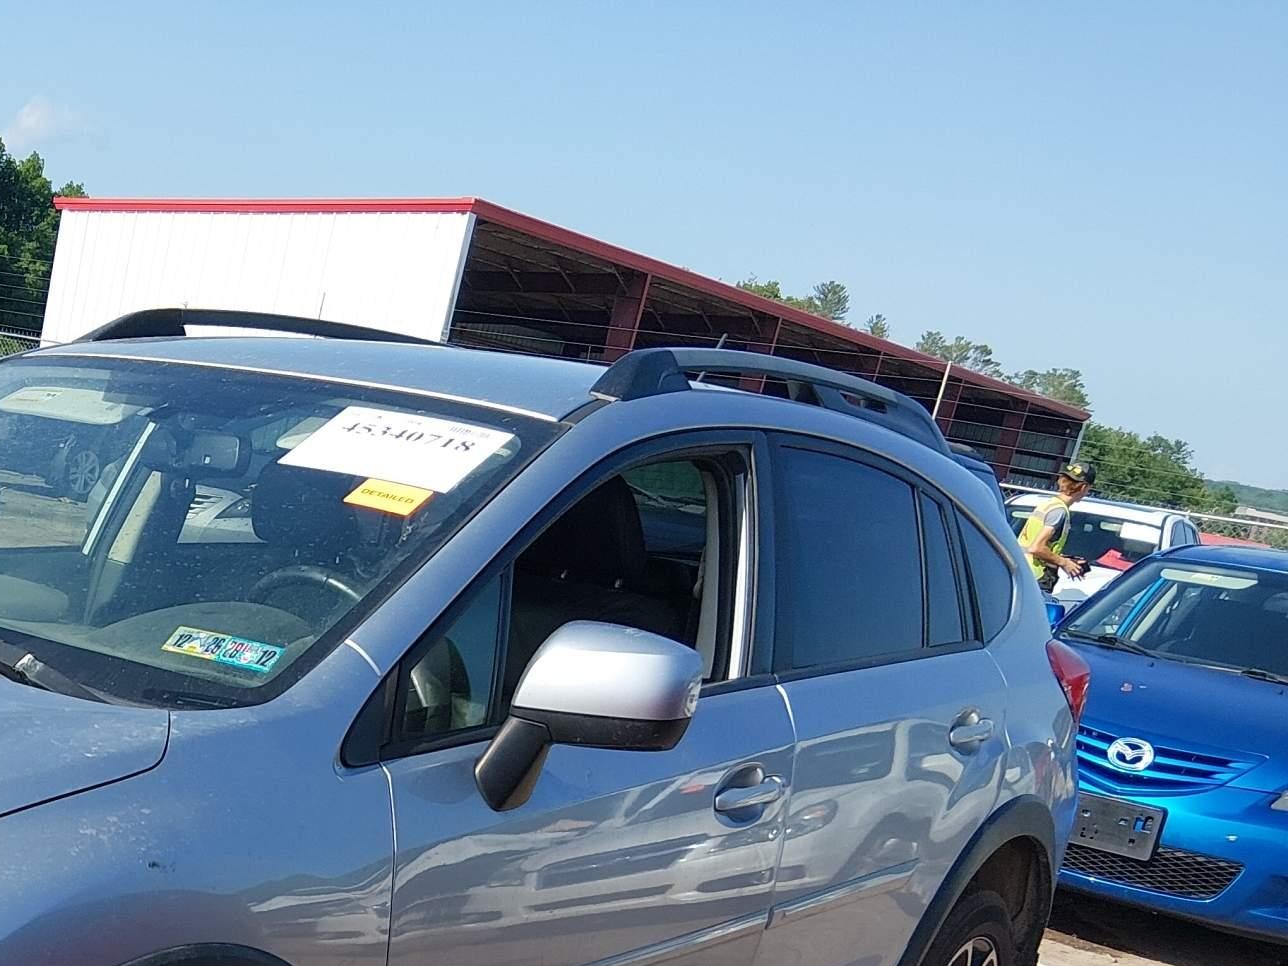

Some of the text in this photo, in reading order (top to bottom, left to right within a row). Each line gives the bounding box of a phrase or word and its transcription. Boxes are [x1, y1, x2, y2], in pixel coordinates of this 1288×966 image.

[342, 421, 476, 452] 45340718
[361, 488, 415, 504] DETAILED
[173, 633, 192, 648] 12
[255, 648, 277, 666] 12
